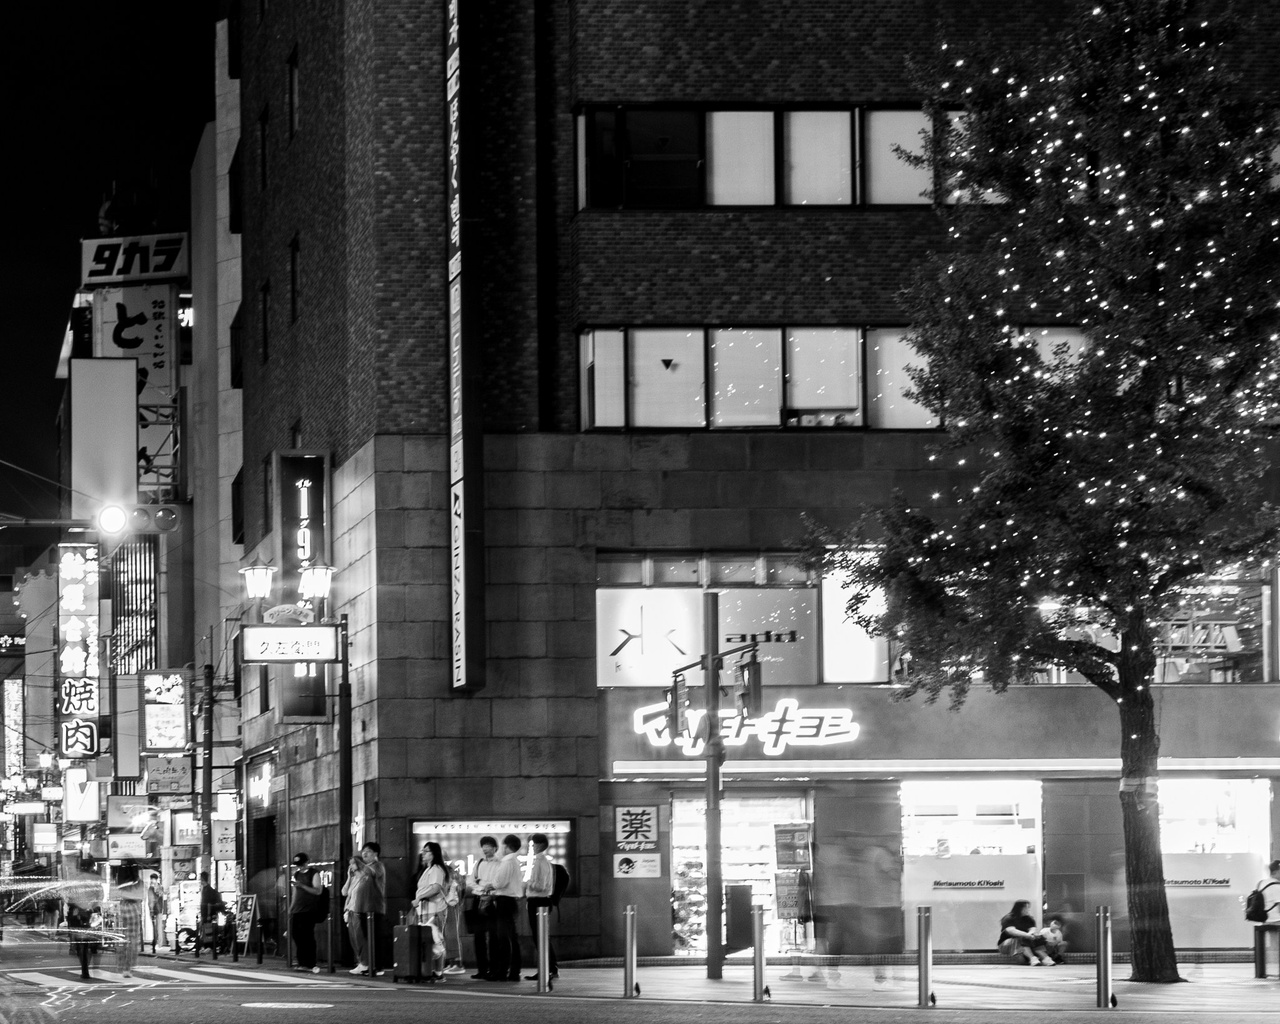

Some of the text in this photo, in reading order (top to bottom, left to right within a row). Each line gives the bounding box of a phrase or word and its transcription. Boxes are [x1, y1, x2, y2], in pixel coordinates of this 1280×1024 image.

[87, 238, 184, 278] タカラ
[62, 678, 98, 754] 焼肉
[622, 809, 652, 840] 薬
